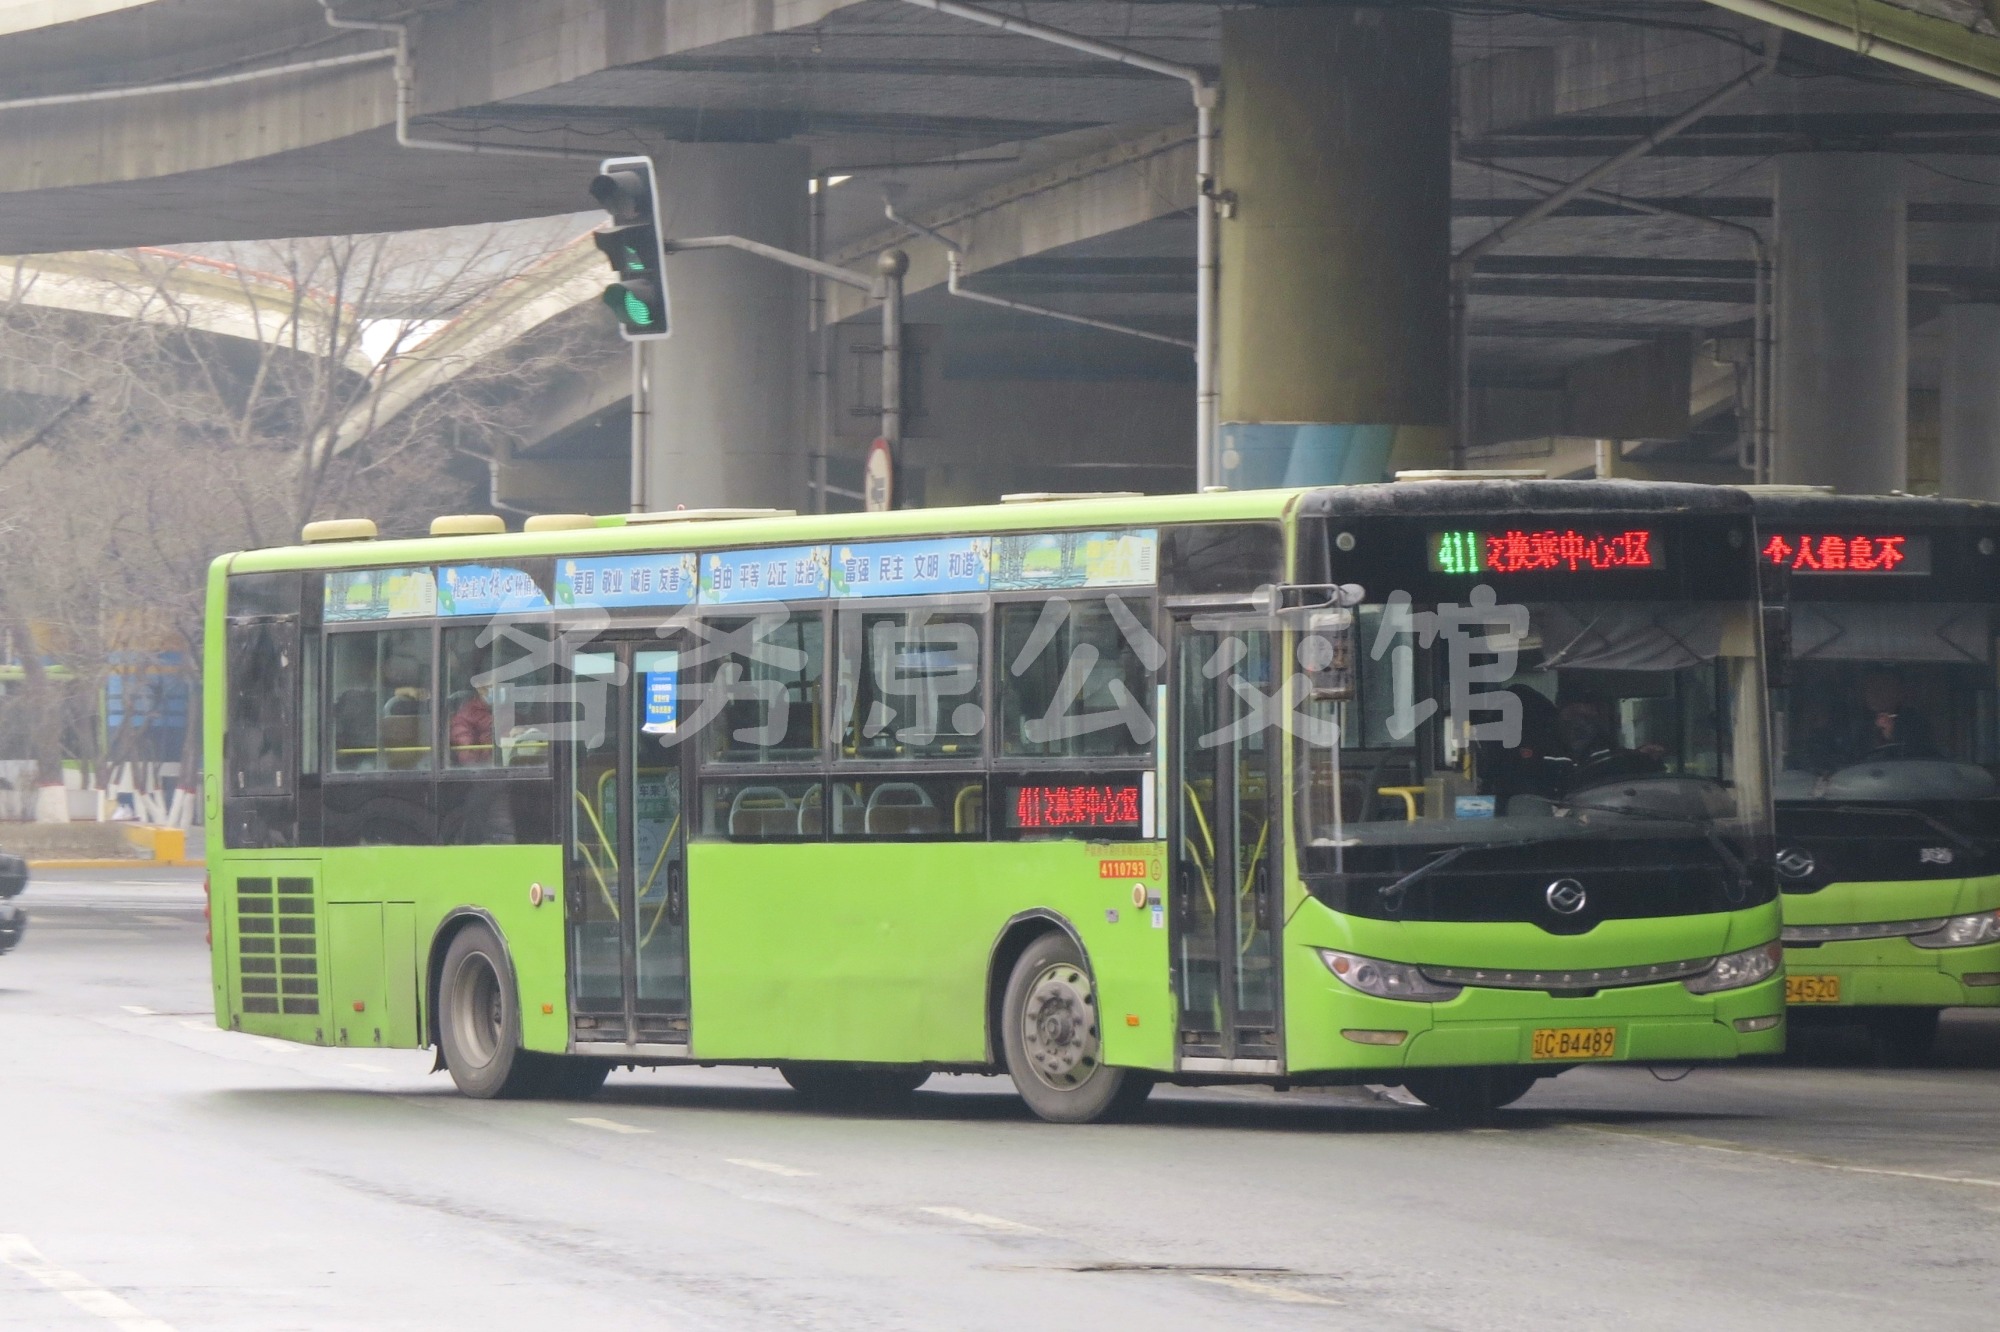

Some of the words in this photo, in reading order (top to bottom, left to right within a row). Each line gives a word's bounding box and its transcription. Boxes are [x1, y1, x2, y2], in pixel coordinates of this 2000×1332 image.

[845, 557, 870, 583] 富强
[879, 555, 905, 581] 民主
[913, 554, 939, 580] 文明
[949, 552, 975, 578] 和谐
[1438, 531, 1479, 573] 411
[1763, 534, 1906, 570] 个人信息不
[574, 571, 595, 595] 爱国
[602, 569, 623, 593] 敬业
[630, 568, 652, 592] 诚信
[659, 567, 680, 591] 友善
[713, 566, 733, 590] 自由
[740, 564, 760, 588] 平等
[767, 562, 788, 586] 公正
[795, 560, 816, 585] 法治
[1017, 787, 1040, 826] 411
[1101, 862, 1145, 877] 4110793
